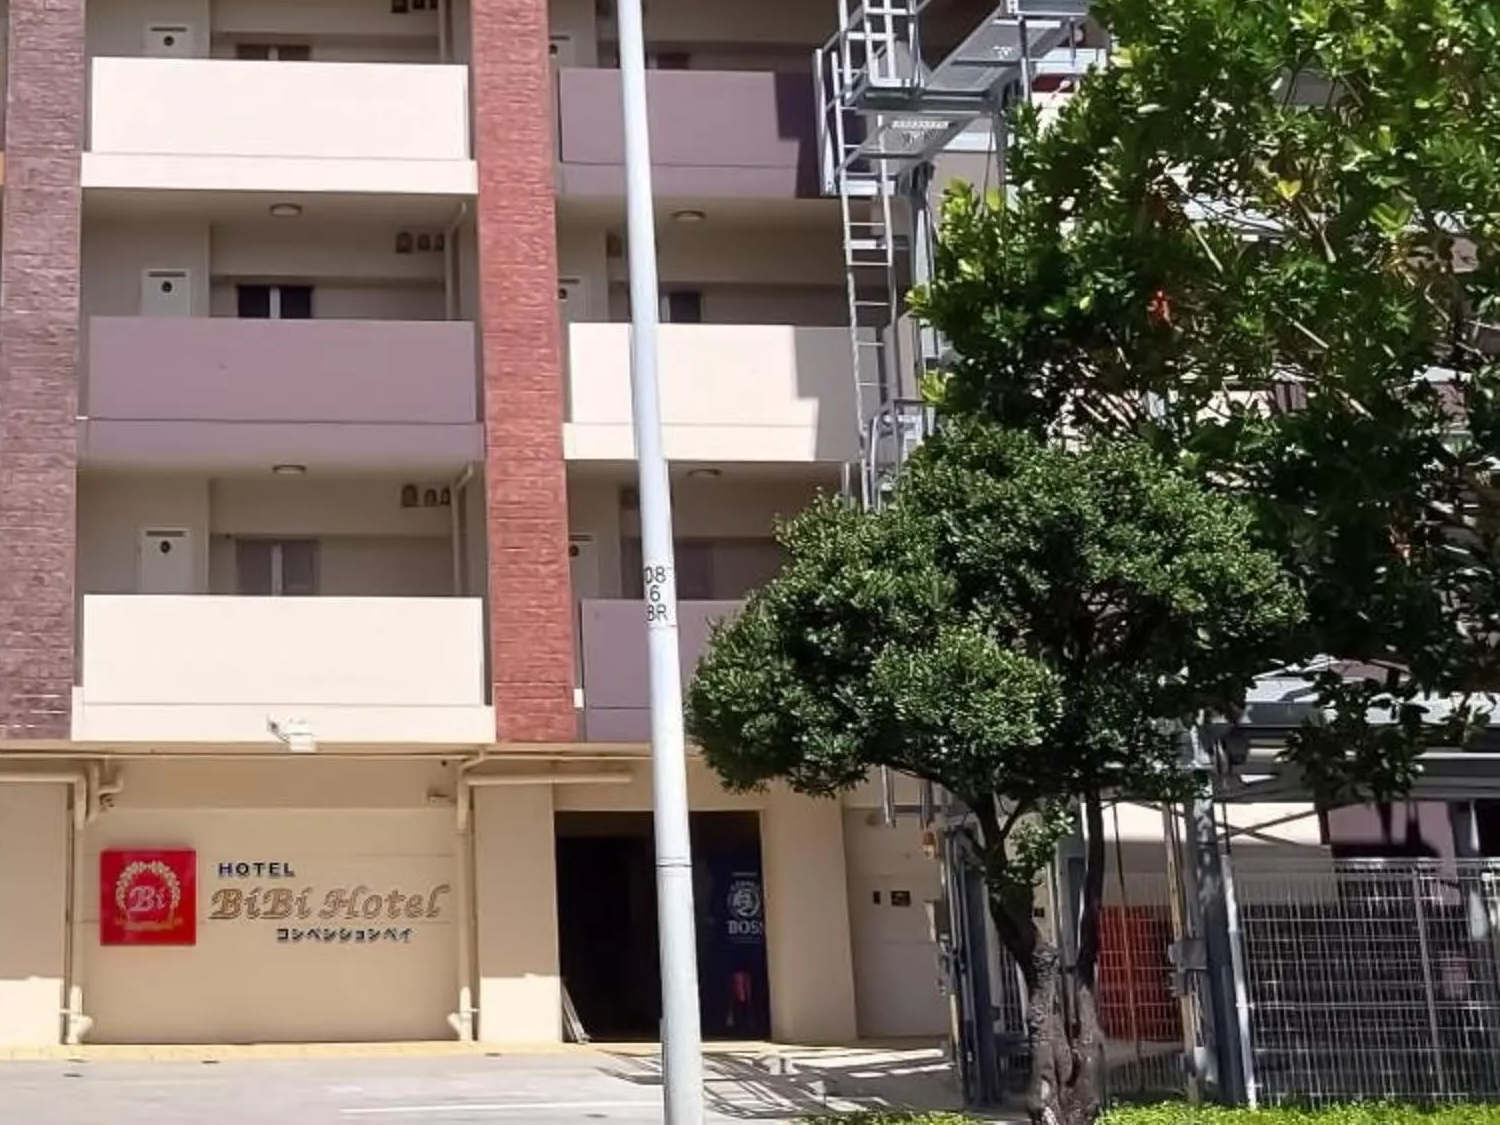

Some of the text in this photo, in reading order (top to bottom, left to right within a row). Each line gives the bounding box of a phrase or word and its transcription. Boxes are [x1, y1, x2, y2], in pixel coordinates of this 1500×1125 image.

[649, 584, 660, 602] 6
[218, 862, 296, 877] HOTEL
[128, 885, 165, 912] Bi
[208, 884, 451, 920] BiBi Hotel
[276, 927, 413, 943] コンベンションベイ
